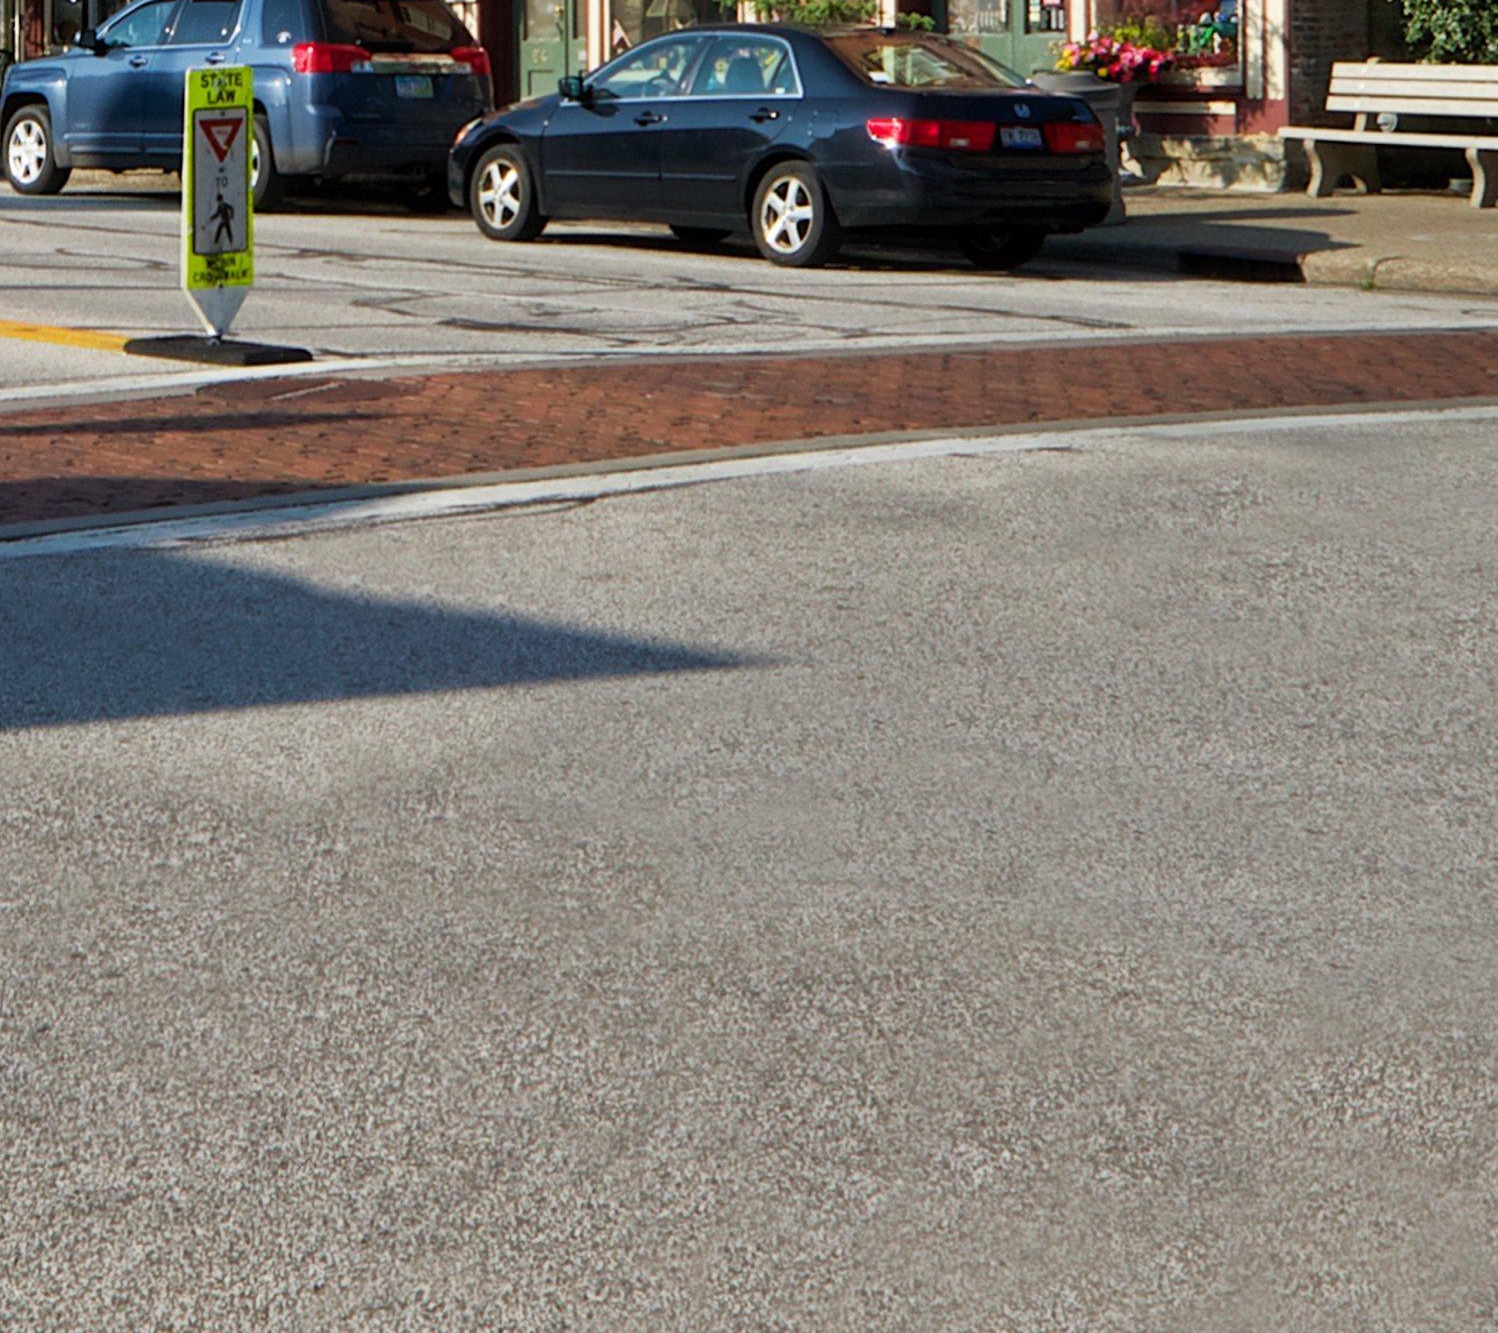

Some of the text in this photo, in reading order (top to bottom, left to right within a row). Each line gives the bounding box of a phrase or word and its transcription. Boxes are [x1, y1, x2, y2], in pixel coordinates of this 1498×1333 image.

[200, 72, 243, 89] STATE
[206, 90, 236, 104] LAW
[215, 176, 229, 187] TO
